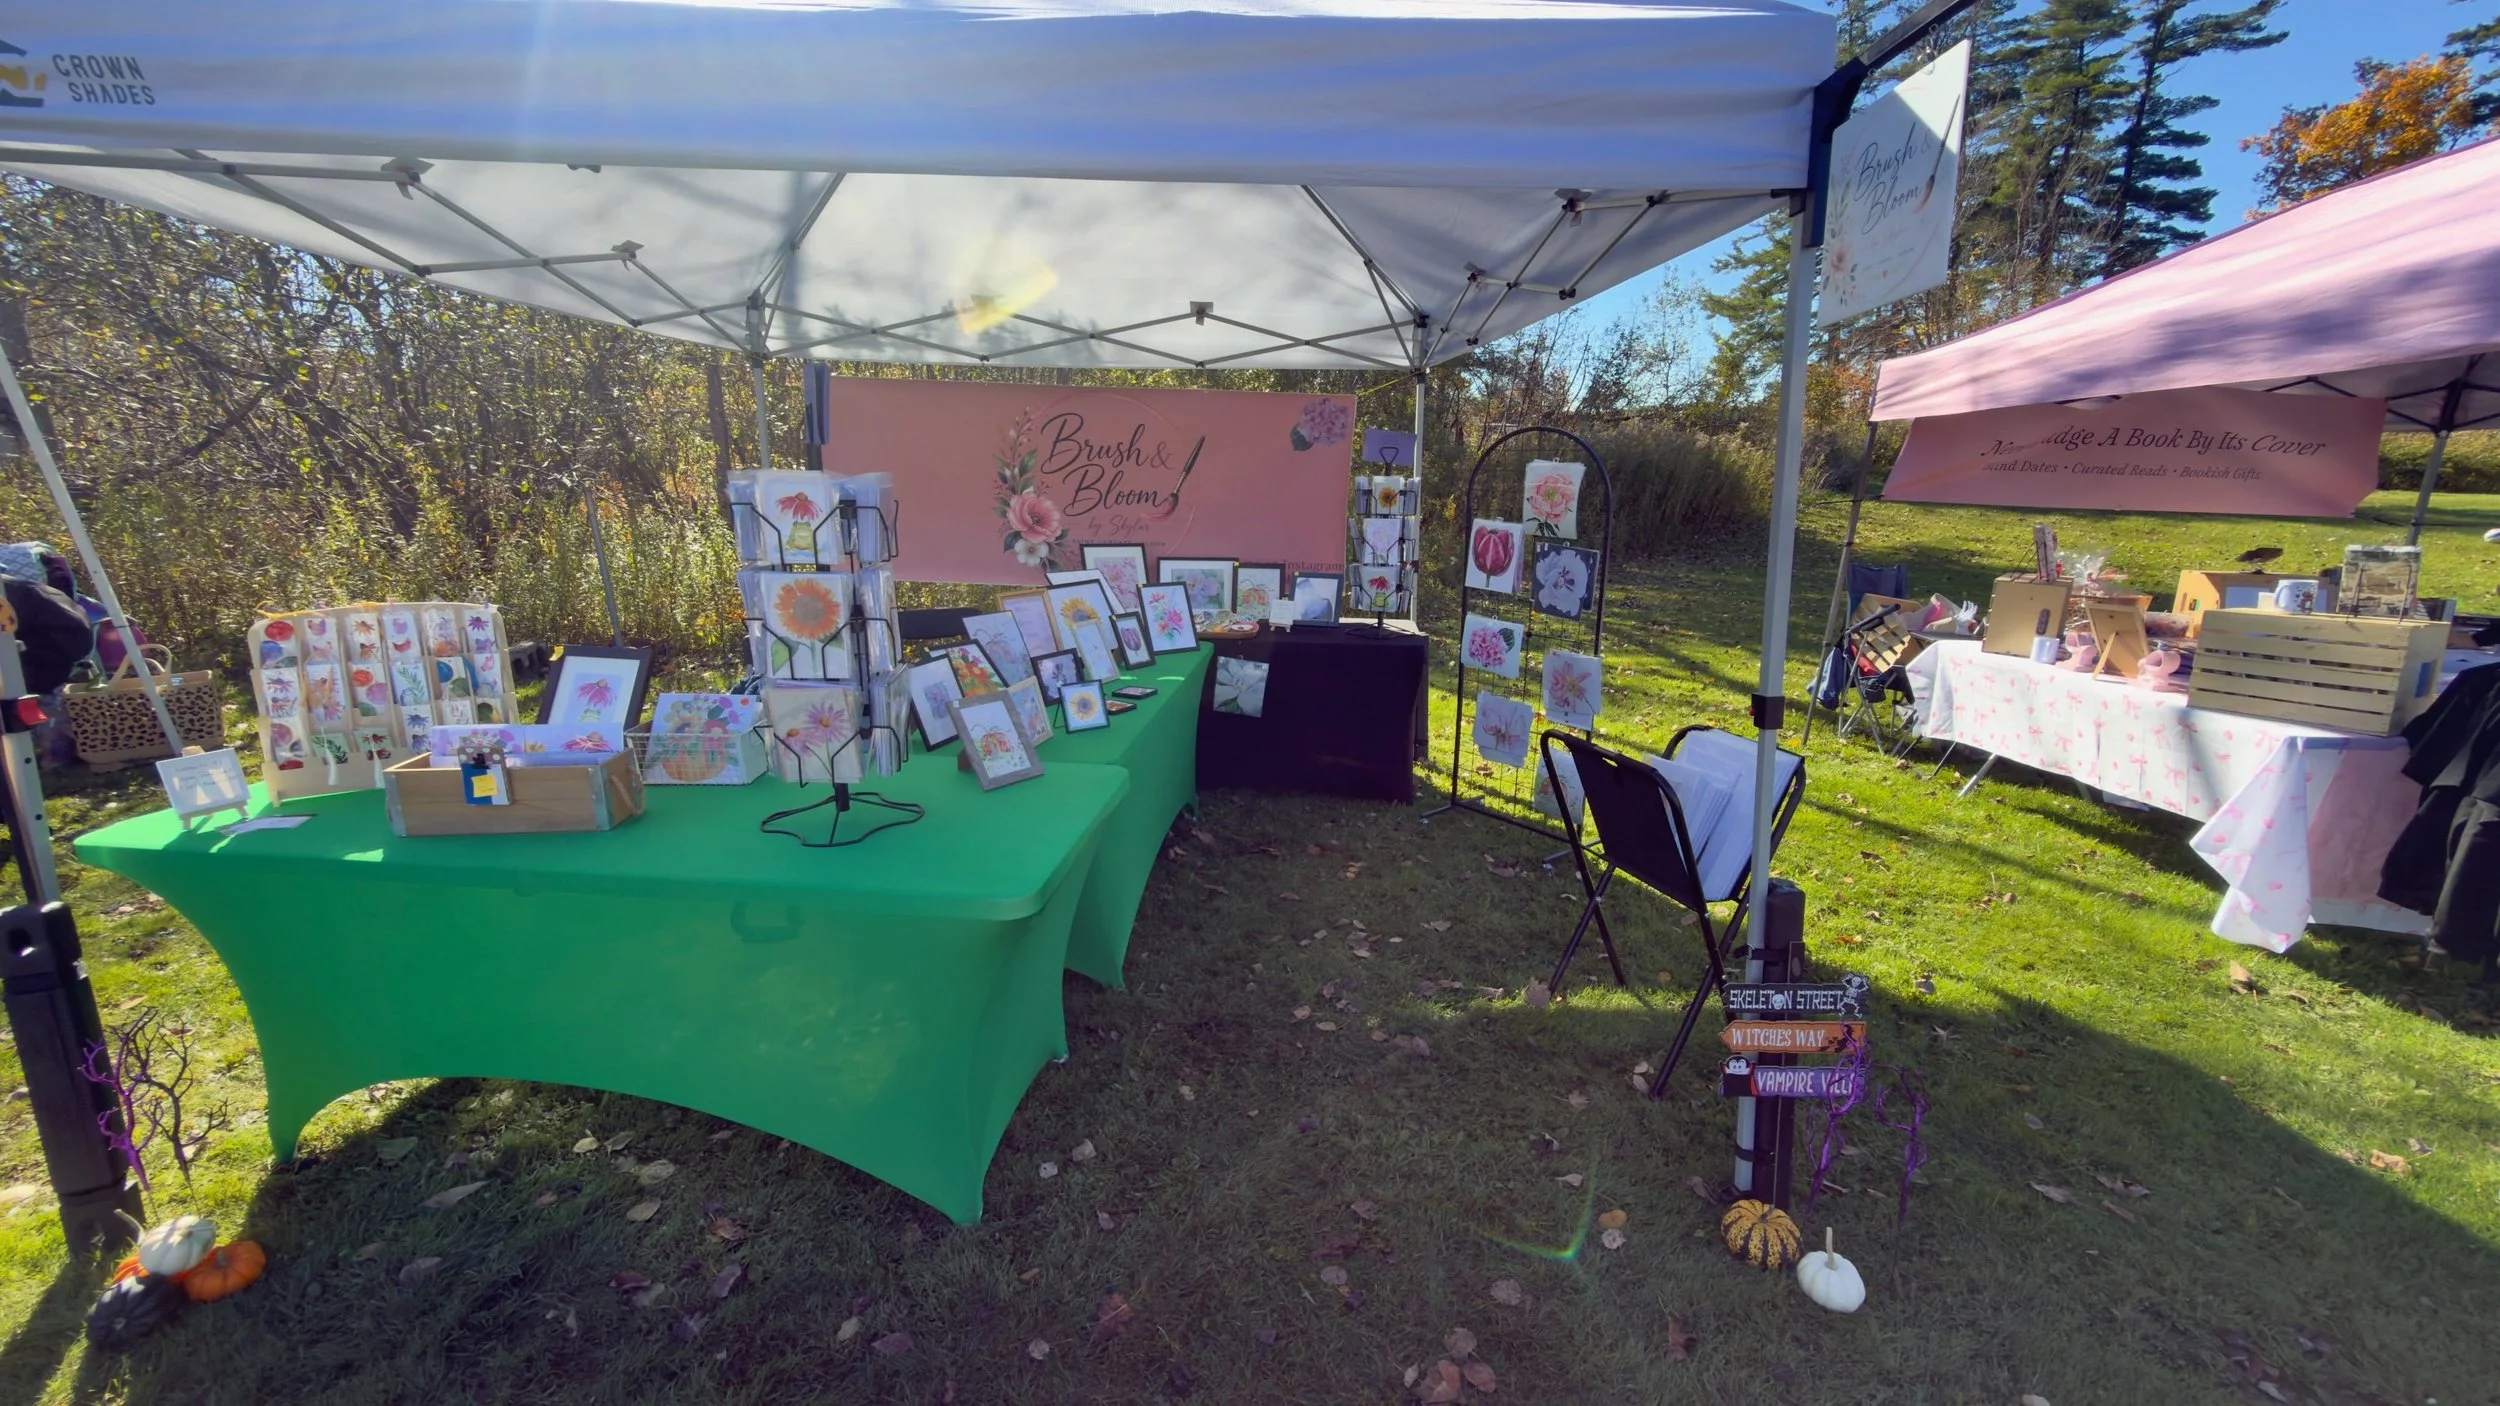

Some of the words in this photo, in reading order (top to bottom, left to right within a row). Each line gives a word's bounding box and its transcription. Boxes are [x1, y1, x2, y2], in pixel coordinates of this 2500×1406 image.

[52, 54, 145, 81] CROWN
[67, 81, 156, 106] SHADES
[1853, 121, 1916, 202] Brush
[1860, 175, 1920, 236] Bloom
[1040, 412, 1149, 475] Brush
[1150, 440, 1175, 470] &
[2040, 424, 2095, 452] dge
[2097, 426, 2121, 448] A
[2123, 427, 2183, 449] Book
[2185, 429, 2215, 455] By
[2217, 430, 2248, 451] Its
[2250, 433, 2326, 457] Cover
[2019, 460, 2058, 473] Dates
[2071, 461, 2126, 476] Curated
[2128, 463, 2168, 477] Reads
[2179, 465, 2230, 480] Bookish
[2231, 467, 2262, 482] Gifts
[1062, 463, 1168, 517] Bloom
[1088, 516, 1102, 537] by
[1286, 560, 1344, 572] nstagram:
[1729, 989, 1793, 1010] SKELETON
[1796, 990, 1844, 1010] STREET
[1731, 1027, 1792, 1047] WITCHES
[1795, 1029, 1826, 1047] WAY
[1757, 1071, 1815, 1093] VAMPIRE
